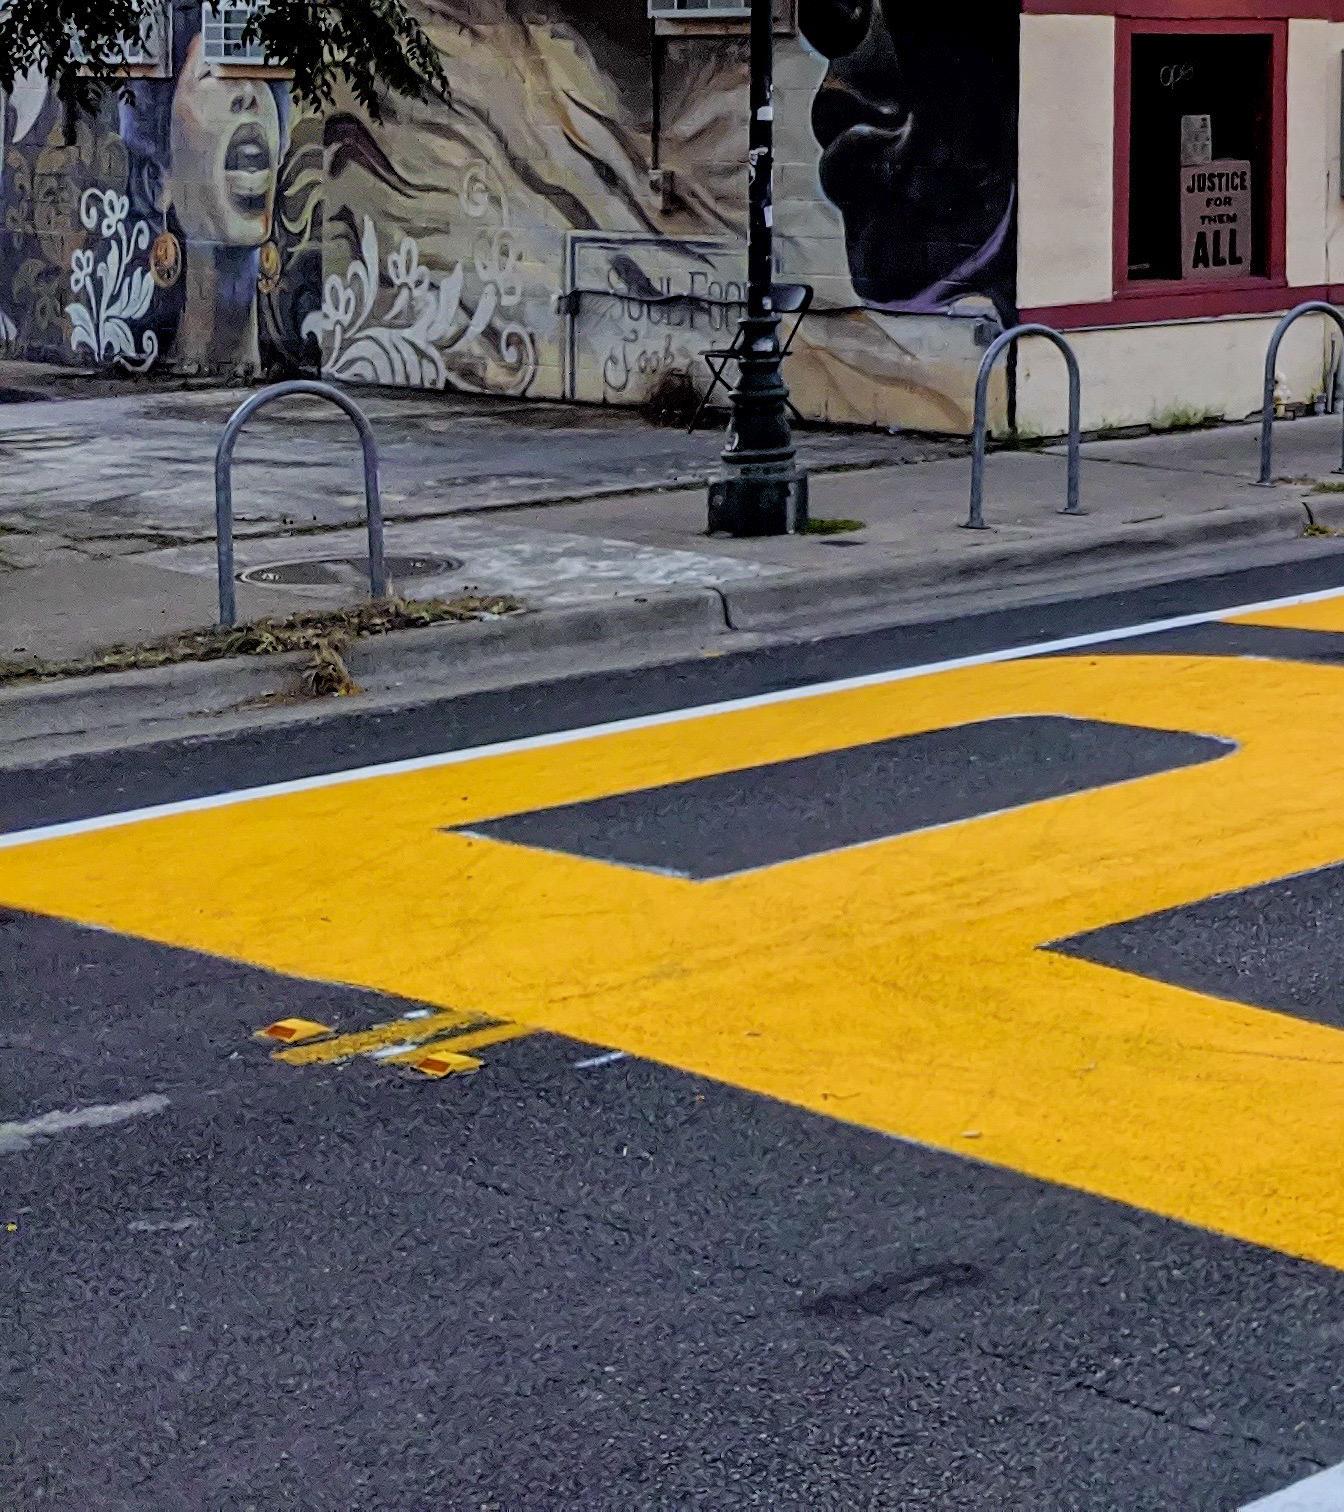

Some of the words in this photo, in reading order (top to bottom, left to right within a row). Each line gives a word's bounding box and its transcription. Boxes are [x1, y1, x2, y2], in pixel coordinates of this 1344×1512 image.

[1187, 171, 1248, 193] JUSTICE
[1205, 197, 1232, 208] FOR
[1192, 228, 1243, 268] ALL
[689, 271, 749, 334] FOO
